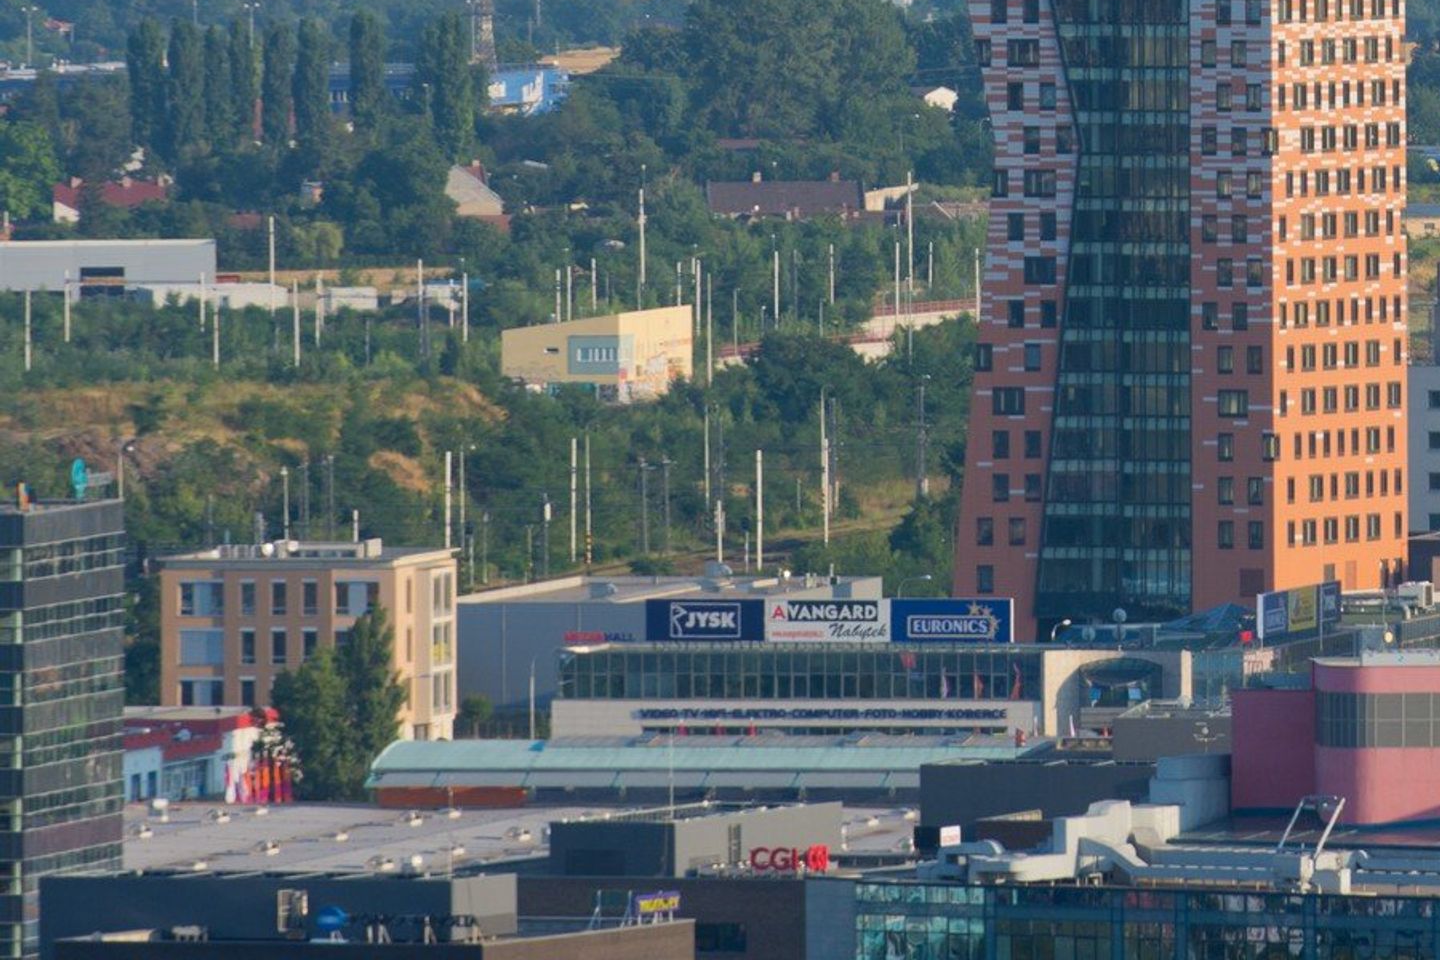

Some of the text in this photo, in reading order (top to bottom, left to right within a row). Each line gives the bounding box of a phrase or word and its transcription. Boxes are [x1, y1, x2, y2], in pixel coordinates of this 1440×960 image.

[684, 611, 736, 628] JYSK
[771, 604, 878, 620] AVANGARD
[912, 619, 988, 633] EURONICS
[750, 847, 798, 870] CGI
